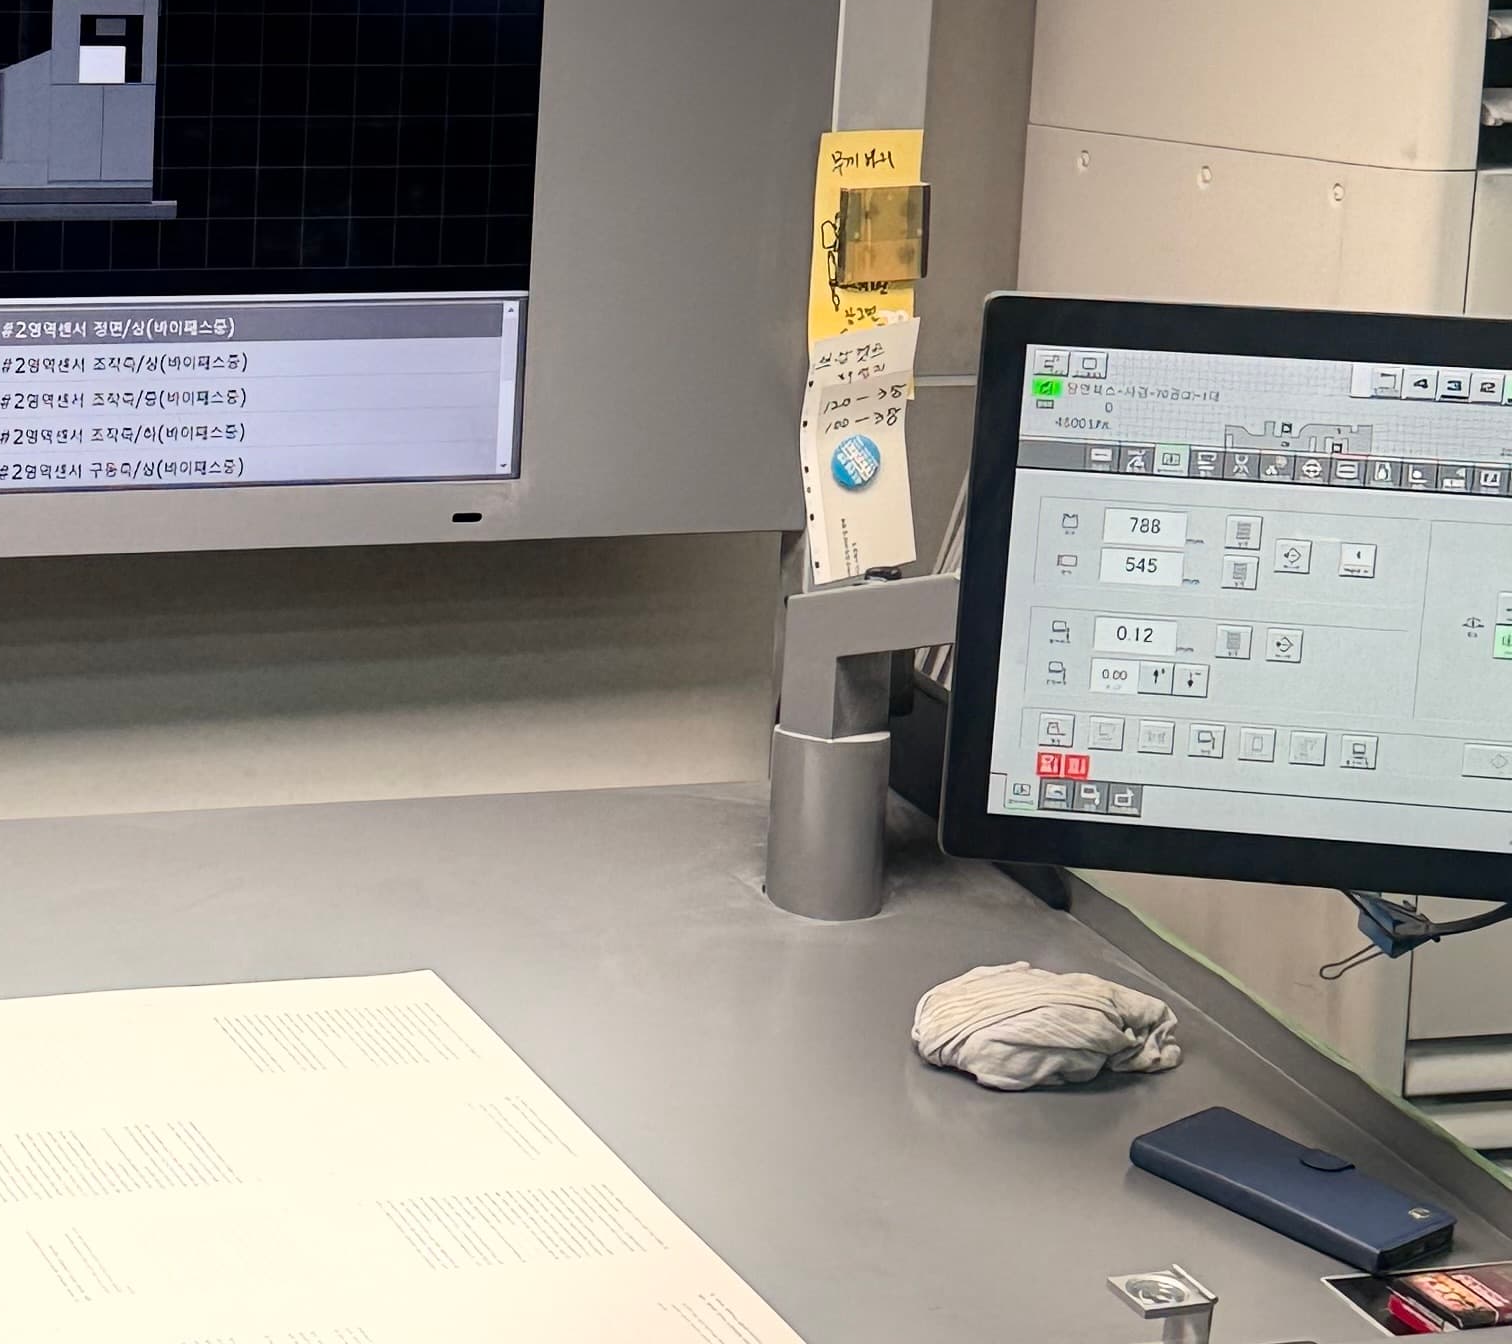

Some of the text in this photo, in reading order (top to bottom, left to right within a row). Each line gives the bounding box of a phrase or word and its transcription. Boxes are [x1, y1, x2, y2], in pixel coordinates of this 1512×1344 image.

[1129, 517, 1161, 534] 788
[1125, 557, 1158, 573] 545
[1116, 626, 1153, 643] 0.12
